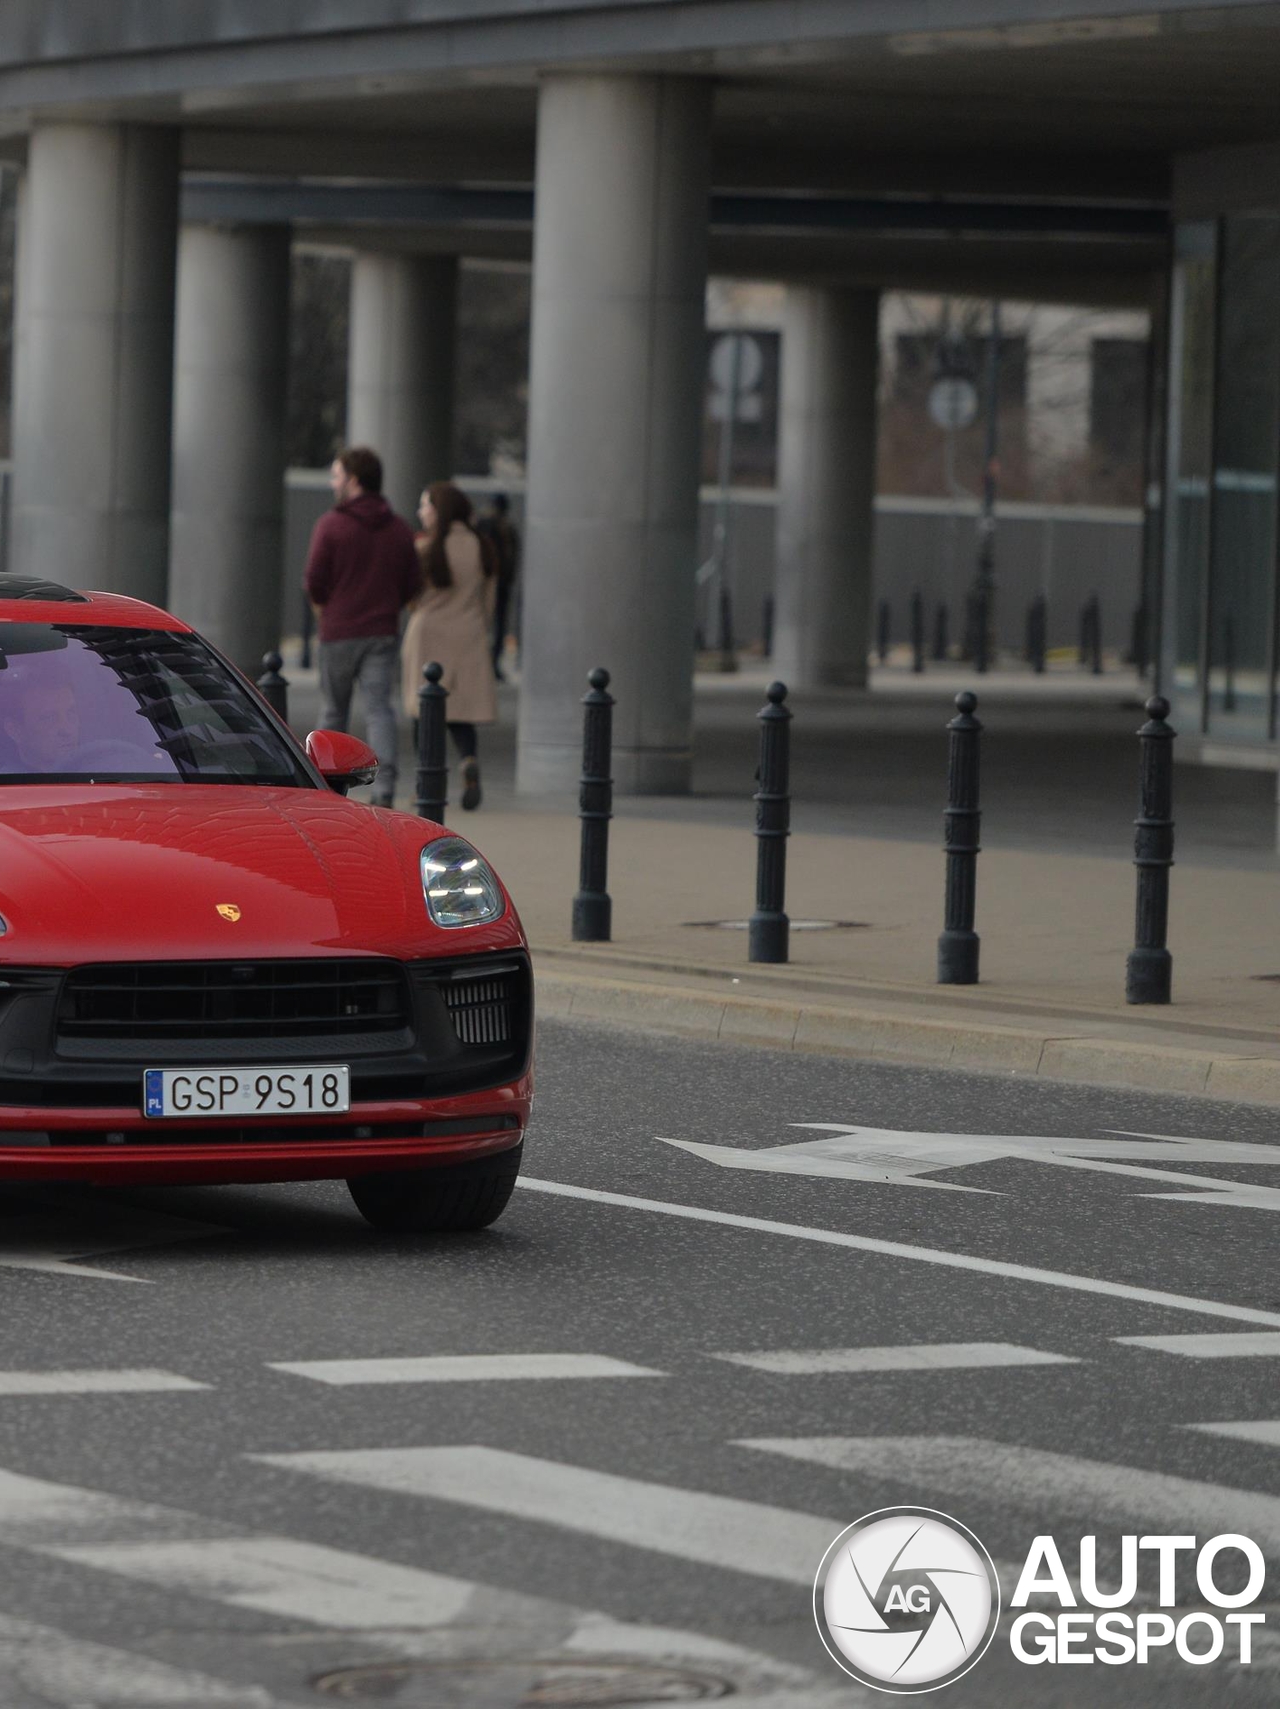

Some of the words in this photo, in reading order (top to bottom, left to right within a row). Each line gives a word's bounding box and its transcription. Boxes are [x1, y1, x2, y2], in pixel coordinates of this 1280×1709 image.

[148, 1098, 161, 1109] PL
[171, 1075, 239, 1111] GSP
[255, 1073, 339, 1110] 9S18
